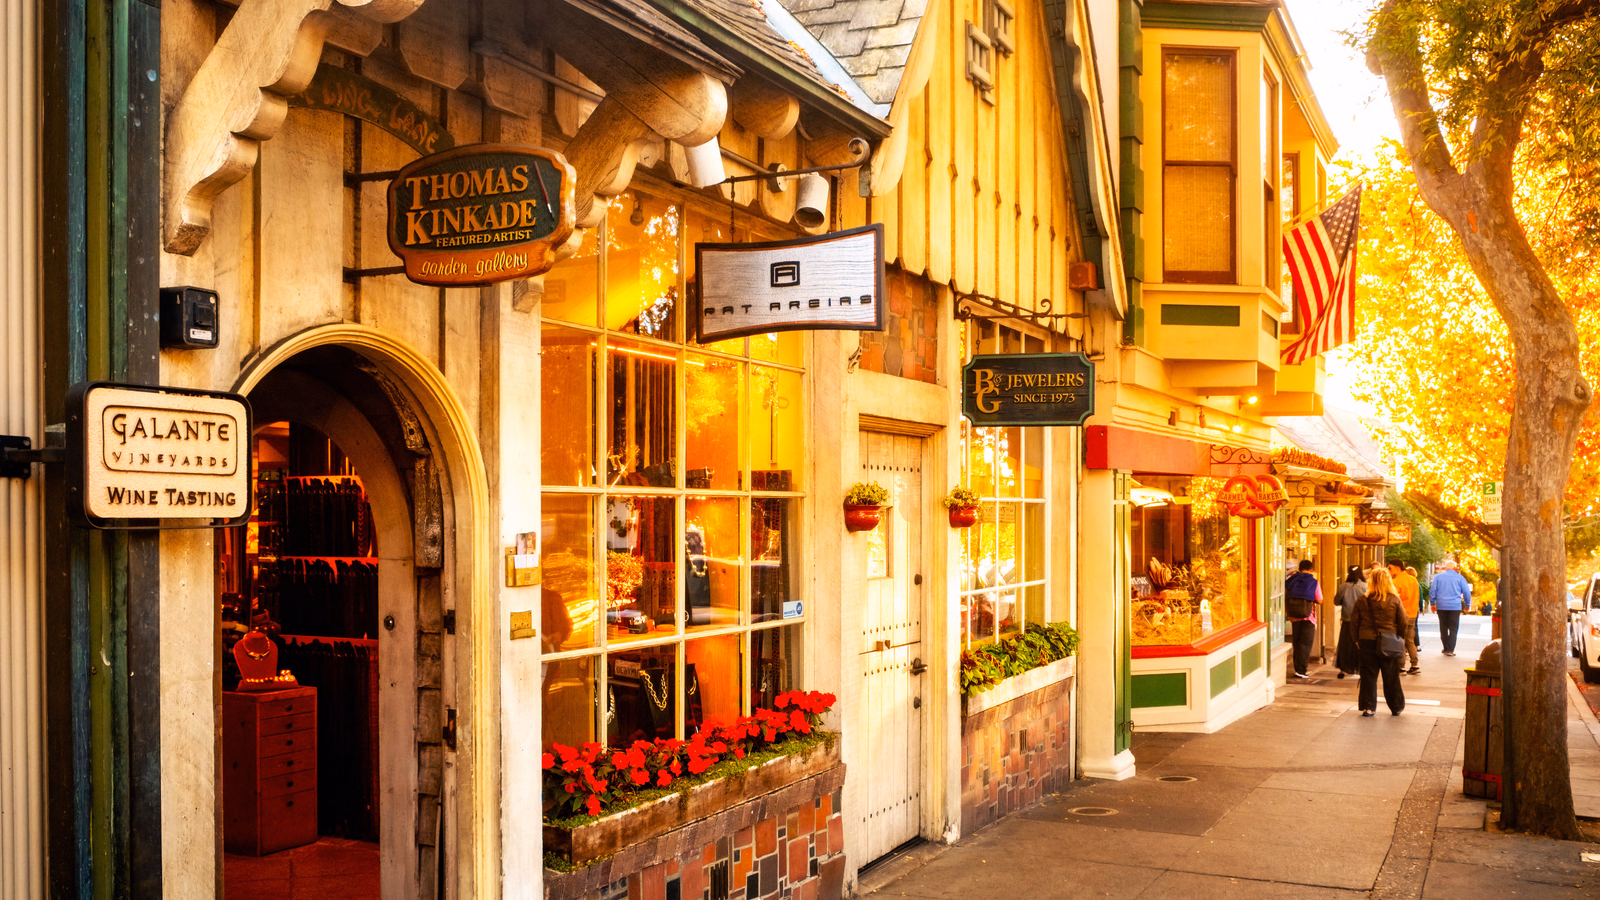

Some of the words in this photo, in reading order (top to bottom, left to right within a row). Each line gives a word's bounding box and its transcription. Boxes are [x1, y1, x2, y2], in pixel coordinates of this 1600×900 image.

[405, 165, 528, 210] THOMAS
[405, 199, 537, 245] KINKADE
[436, 233, 491, 247] FEATURED
[493, 229, 532, 242] ARTIST
[419, 257, 468, 276] garden
[474, 250, 528, 277] gallery
[704, 304, 752, 317] PAT
[769, 294, 872, 311] AREIAS
[1005, 372, 1084, 391] JEWELERS
[1013, 393, 1046, 403] SINCE
[1050, 393, 1075, 403] 1973
[112, 413, 229, 445] GALANTE
[112, 451, 228, 467] VINEYARDS
[107, 486, 158, 505] WINE
[165, 488, 236, 506] TASTING
[1221, 492, 1245, 501] CARMEL
[1258, 491, 1283, 501] BAKERY
[1485, 484, 1493, 494] 2
[1485, 496, 1500, 505] PARK
